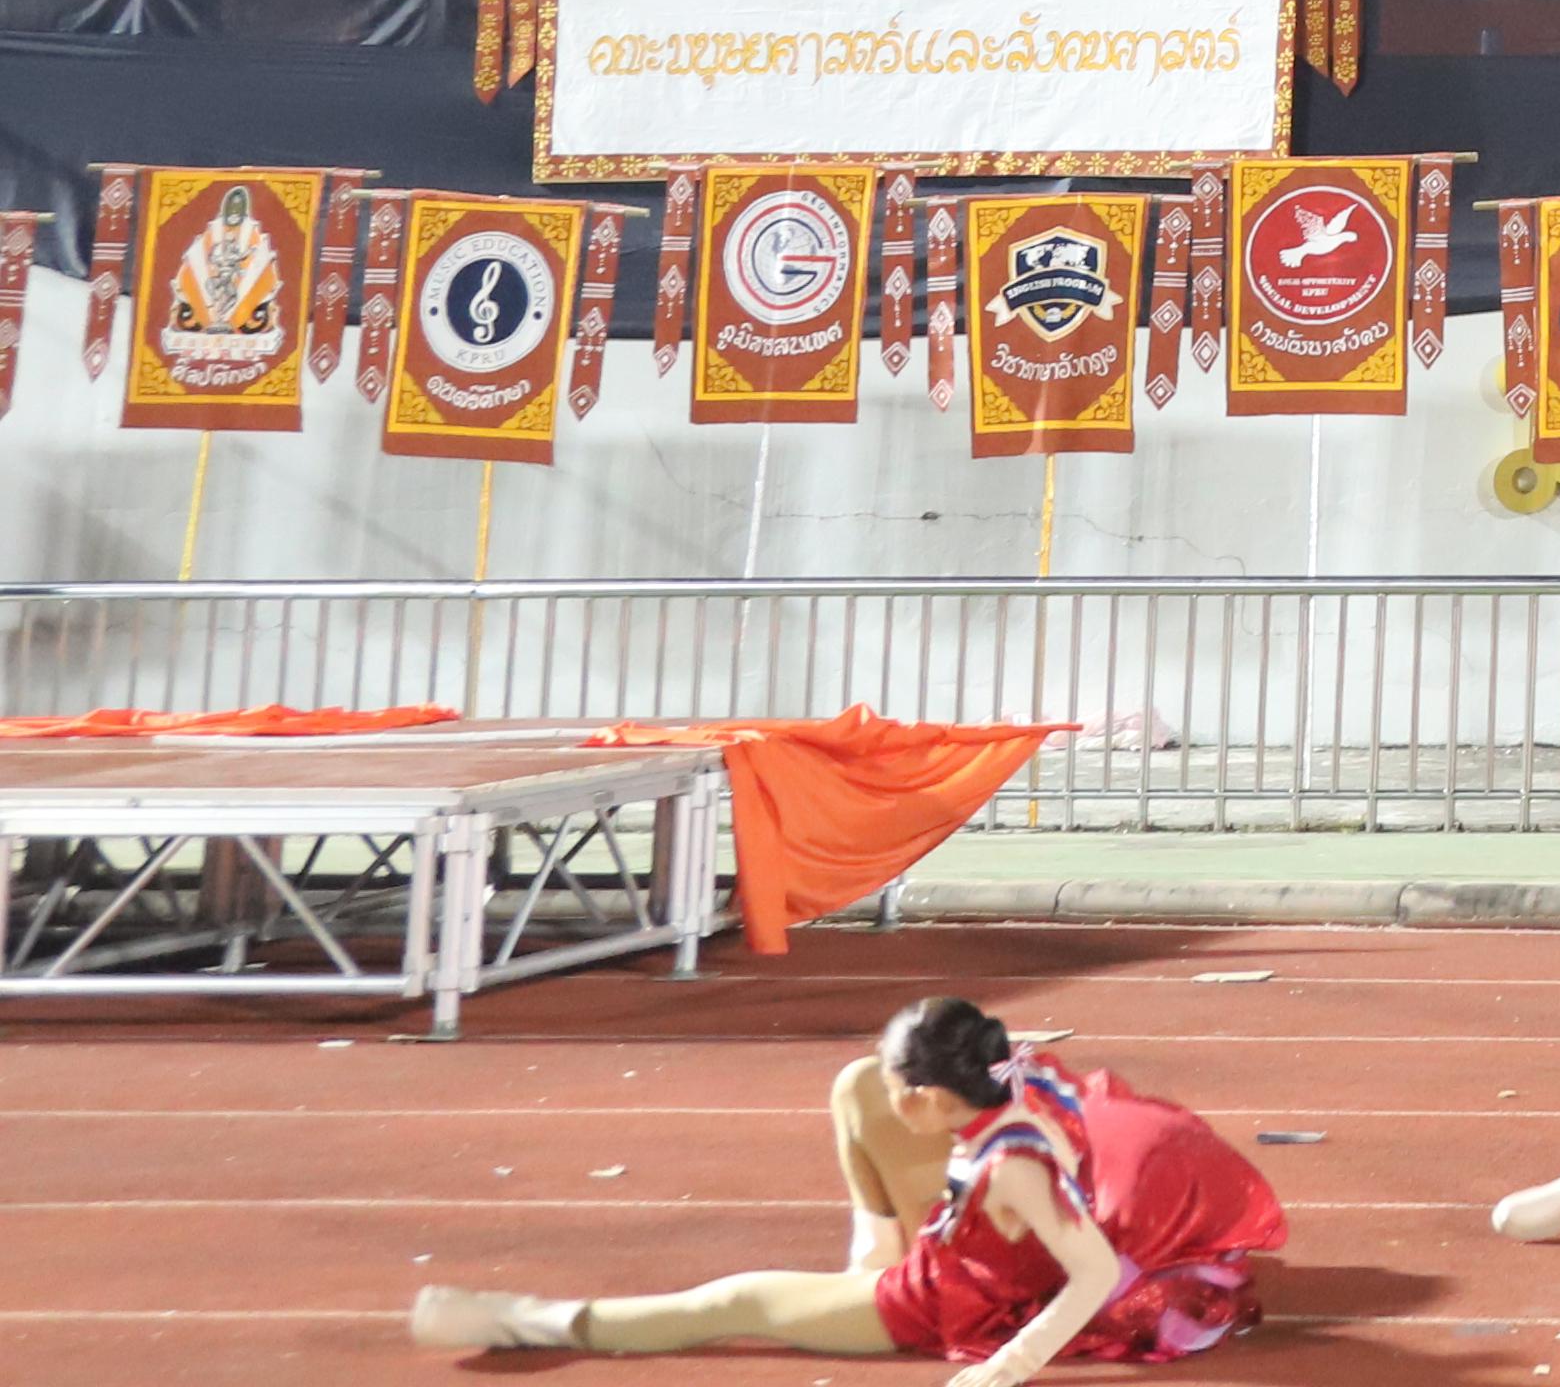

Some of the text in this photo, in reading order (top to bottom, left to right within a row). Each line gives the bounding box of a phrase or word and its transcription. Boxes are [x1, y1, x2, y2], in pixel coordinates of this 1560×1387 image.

[472, 239, 547, 307] EDUCATION
[1259, 274, 1377, 315] SOCIAL DEVELOPMENT
